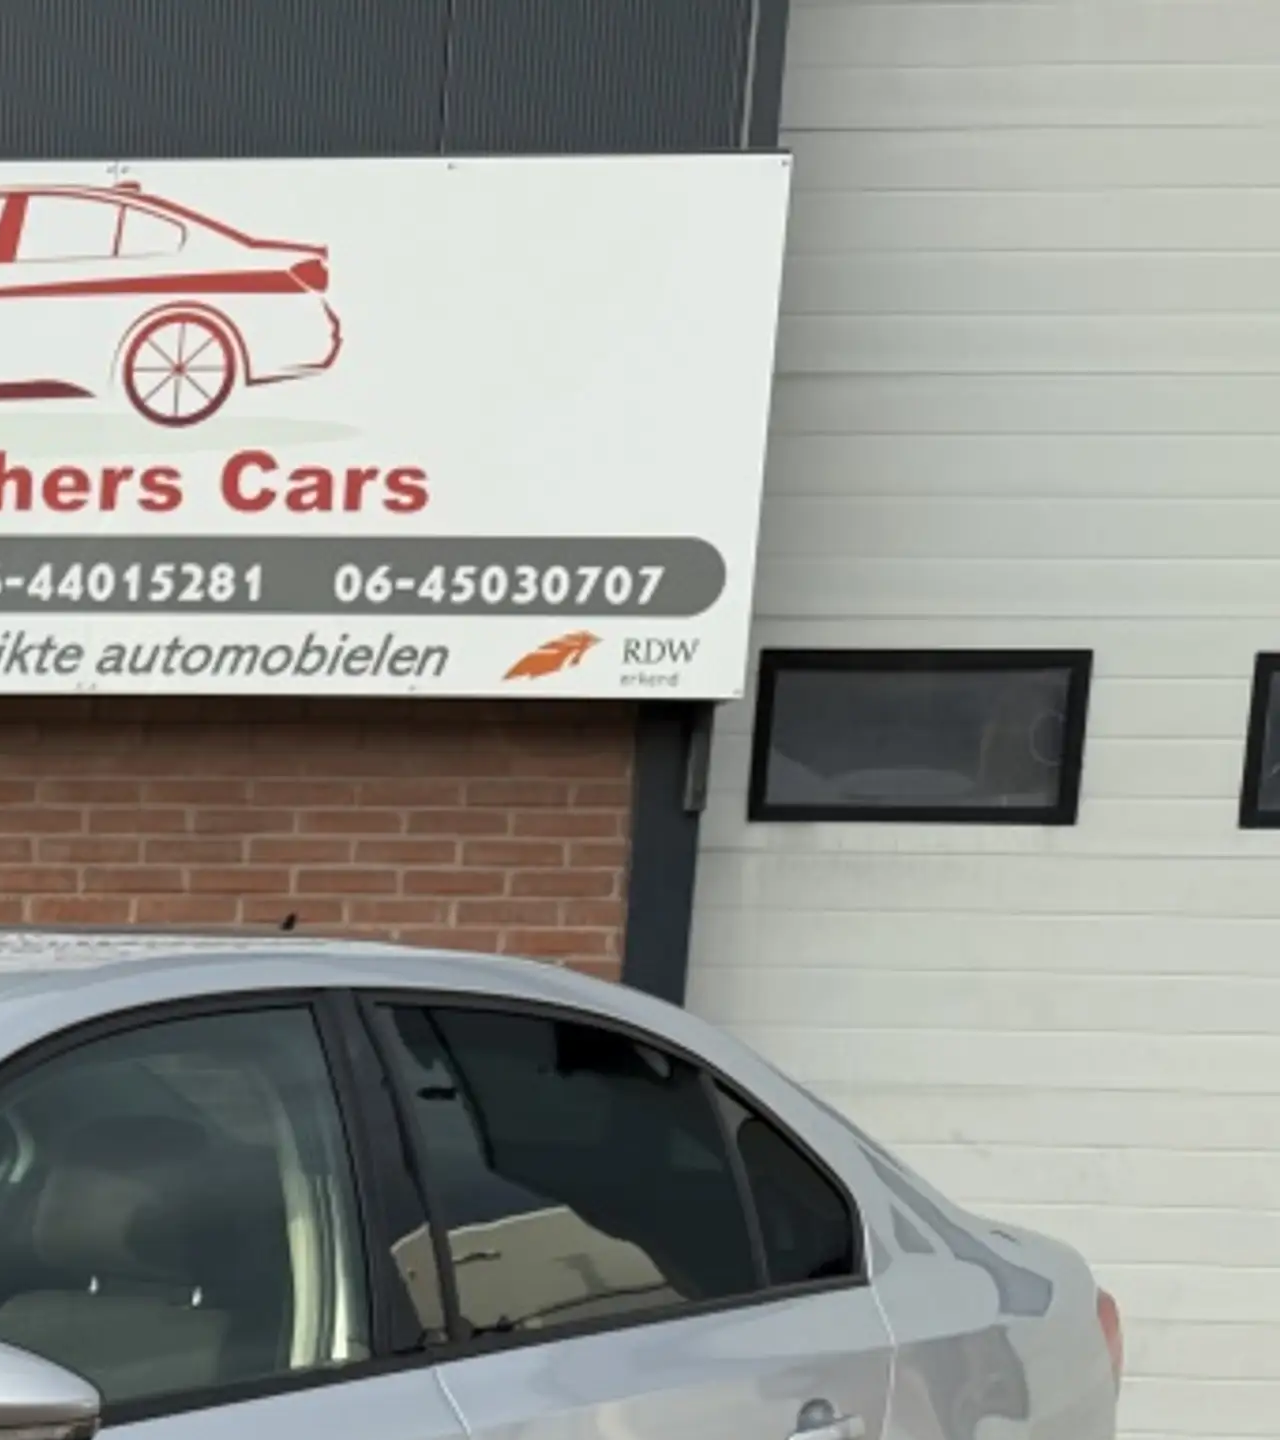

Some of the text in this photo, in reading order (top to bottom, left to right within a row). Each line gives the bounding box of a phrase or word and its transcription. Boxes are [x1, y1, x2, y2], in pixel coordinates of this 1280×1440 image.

[222, 450, 428, 513] Cars
[334, 563, 666, 606] 06-45030707
[95, 632, 450, 681] automobielen
[622, 637, 700, 664] RDW
